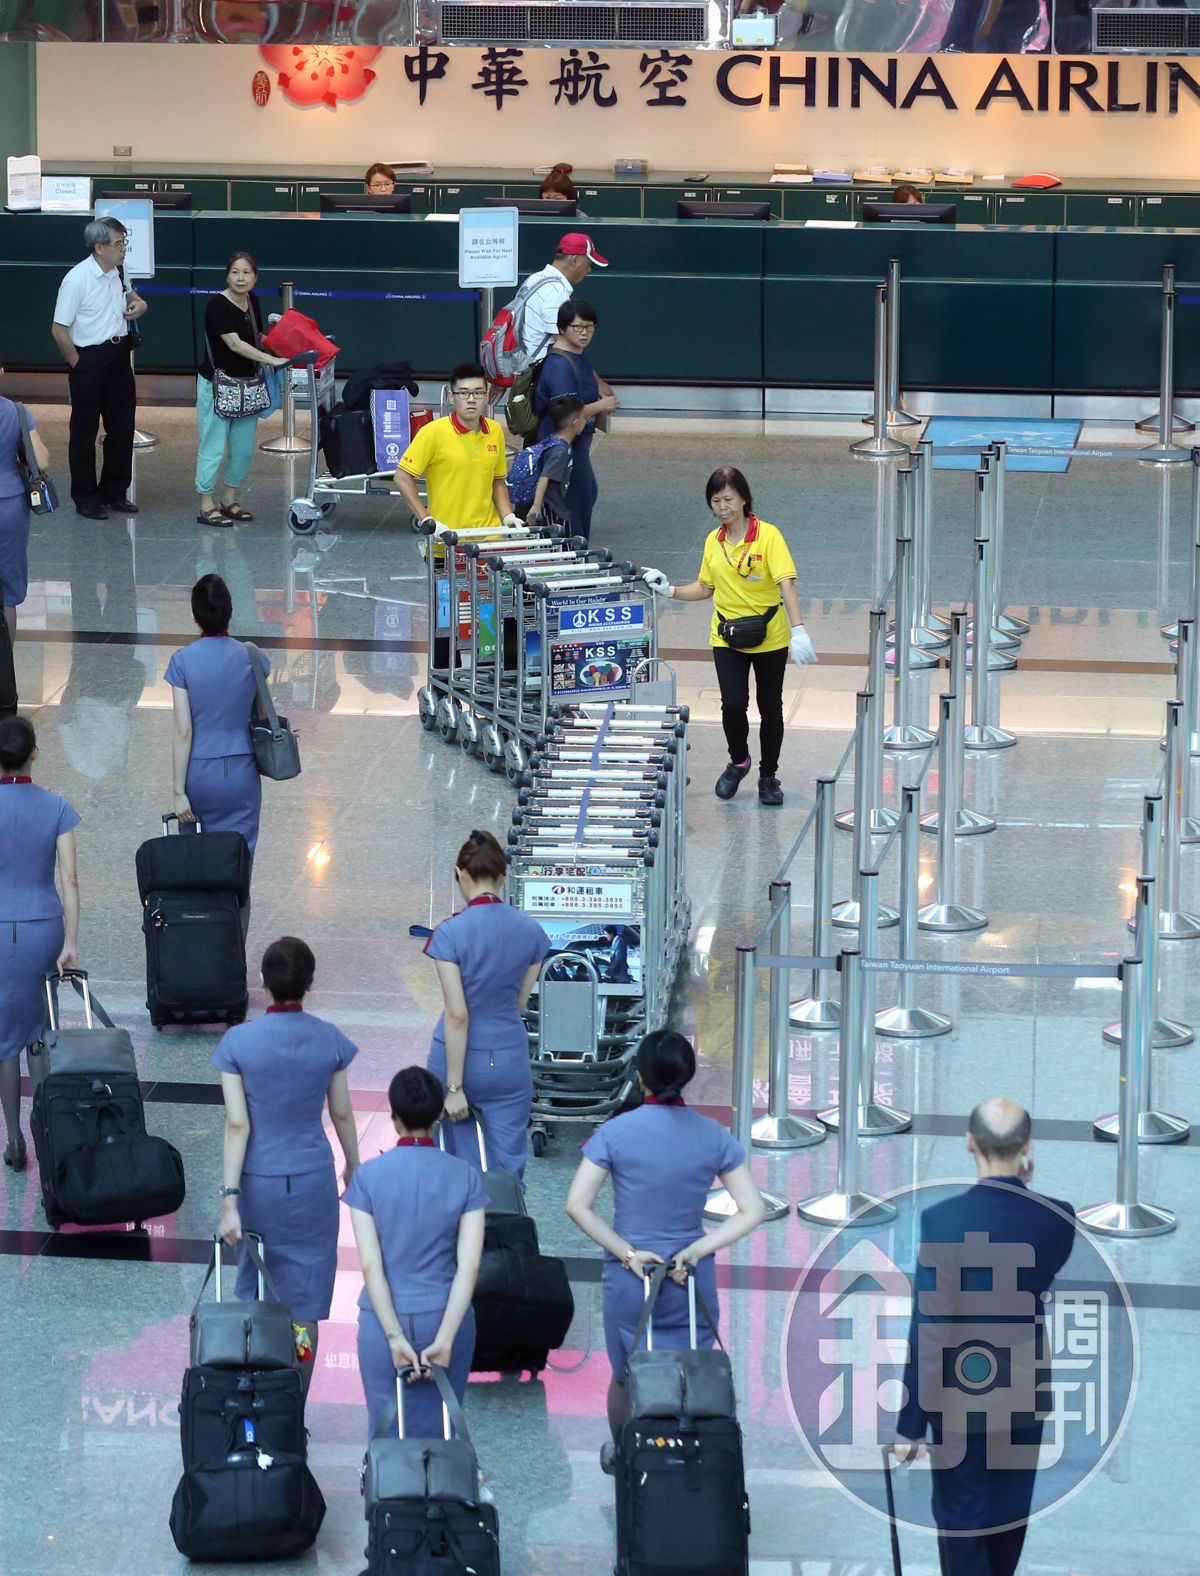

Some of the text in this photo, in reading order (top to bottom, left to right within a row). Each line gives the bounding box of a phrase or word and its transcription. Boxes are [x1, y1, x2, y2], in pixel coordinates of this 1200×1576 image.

[404, 46, 694, 112] 中華航空
[716, 54, 958, 109] CHINA
[1028, 447, 1053, 455] Taoyuan
[588, 606, 632, 623] KSS
[585, 646, 616, 658] KSS
[860, 960, 1010, 975] Taiwan Taoyuan International Airport
